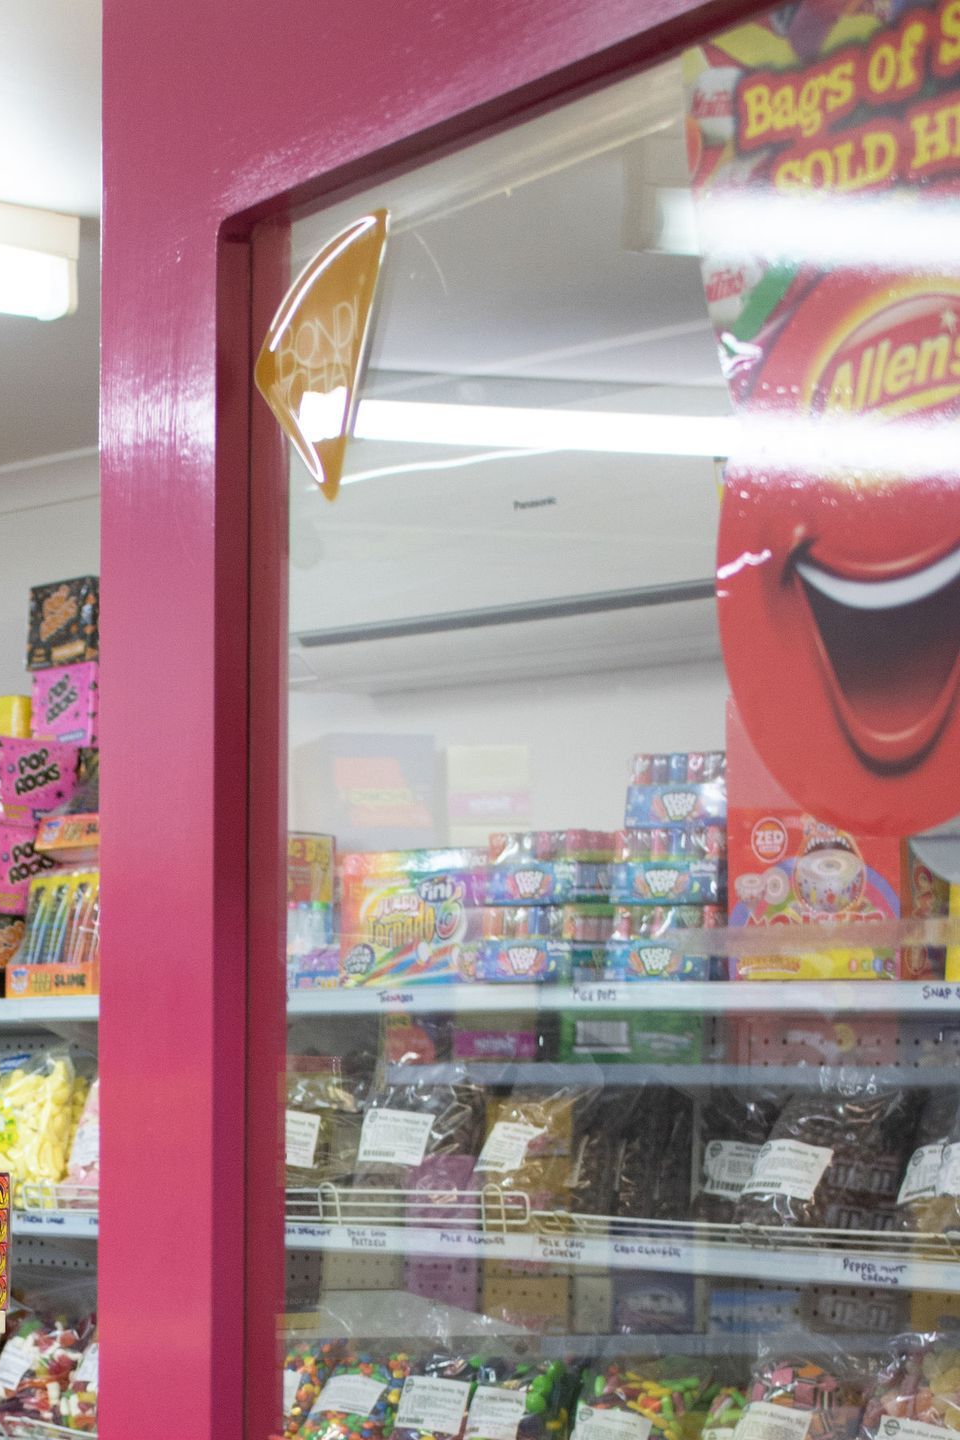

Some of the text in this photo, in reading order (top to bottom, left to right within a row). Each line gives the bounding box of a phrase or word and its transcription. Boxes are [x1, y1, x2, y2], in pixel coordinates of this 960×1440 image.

[745, 62, 855, 139] Bags
[868, 23, 925, 93] of
[776, 131, 898, 194] SOLD
[513, 497, 557, 511] Panasonic
[17, 748, 49, 774] POP
[15, 763, 61, 795] ROCKS
[756, 831, 785, 844] ZED
[53, 974, 86, 987] SLIME
[922, 985, 952, 1000] SNAP
